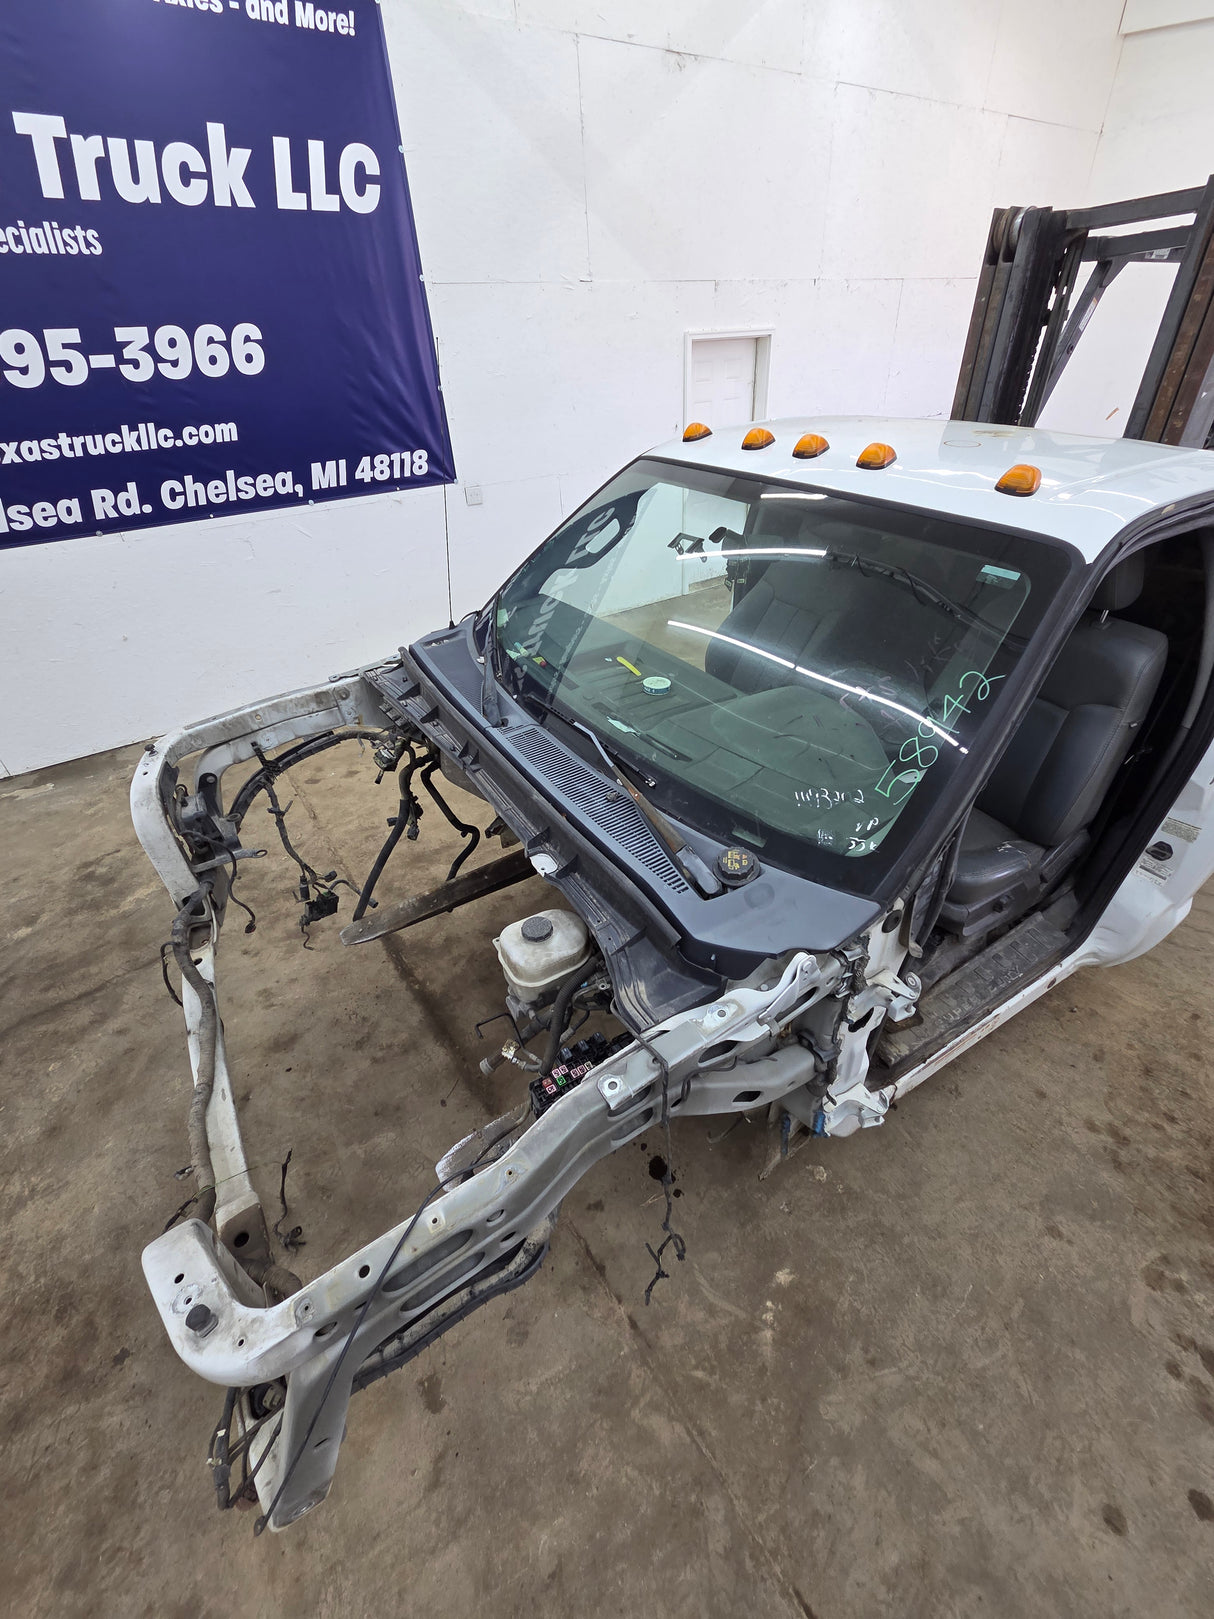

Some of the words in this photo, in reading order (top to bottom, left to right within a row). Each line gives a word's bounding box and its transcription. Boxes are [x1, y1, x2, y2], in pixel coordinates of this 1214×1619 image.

[245, 0, 288, 26] and
[294, 1, 355, 36] More!
[11, 111, 256, 208] Truck
[272, 136, 381, 214] LLC
[0, 322, 266, 389] 95-3966
[91, 482, 153, 520] Rd.
[161, 471, 303, 510] Chelsea,
[311, 459, 347, 489] MI
[355, 449, 429, 483] 48118
[874, 671, 1006, 806] 58942
